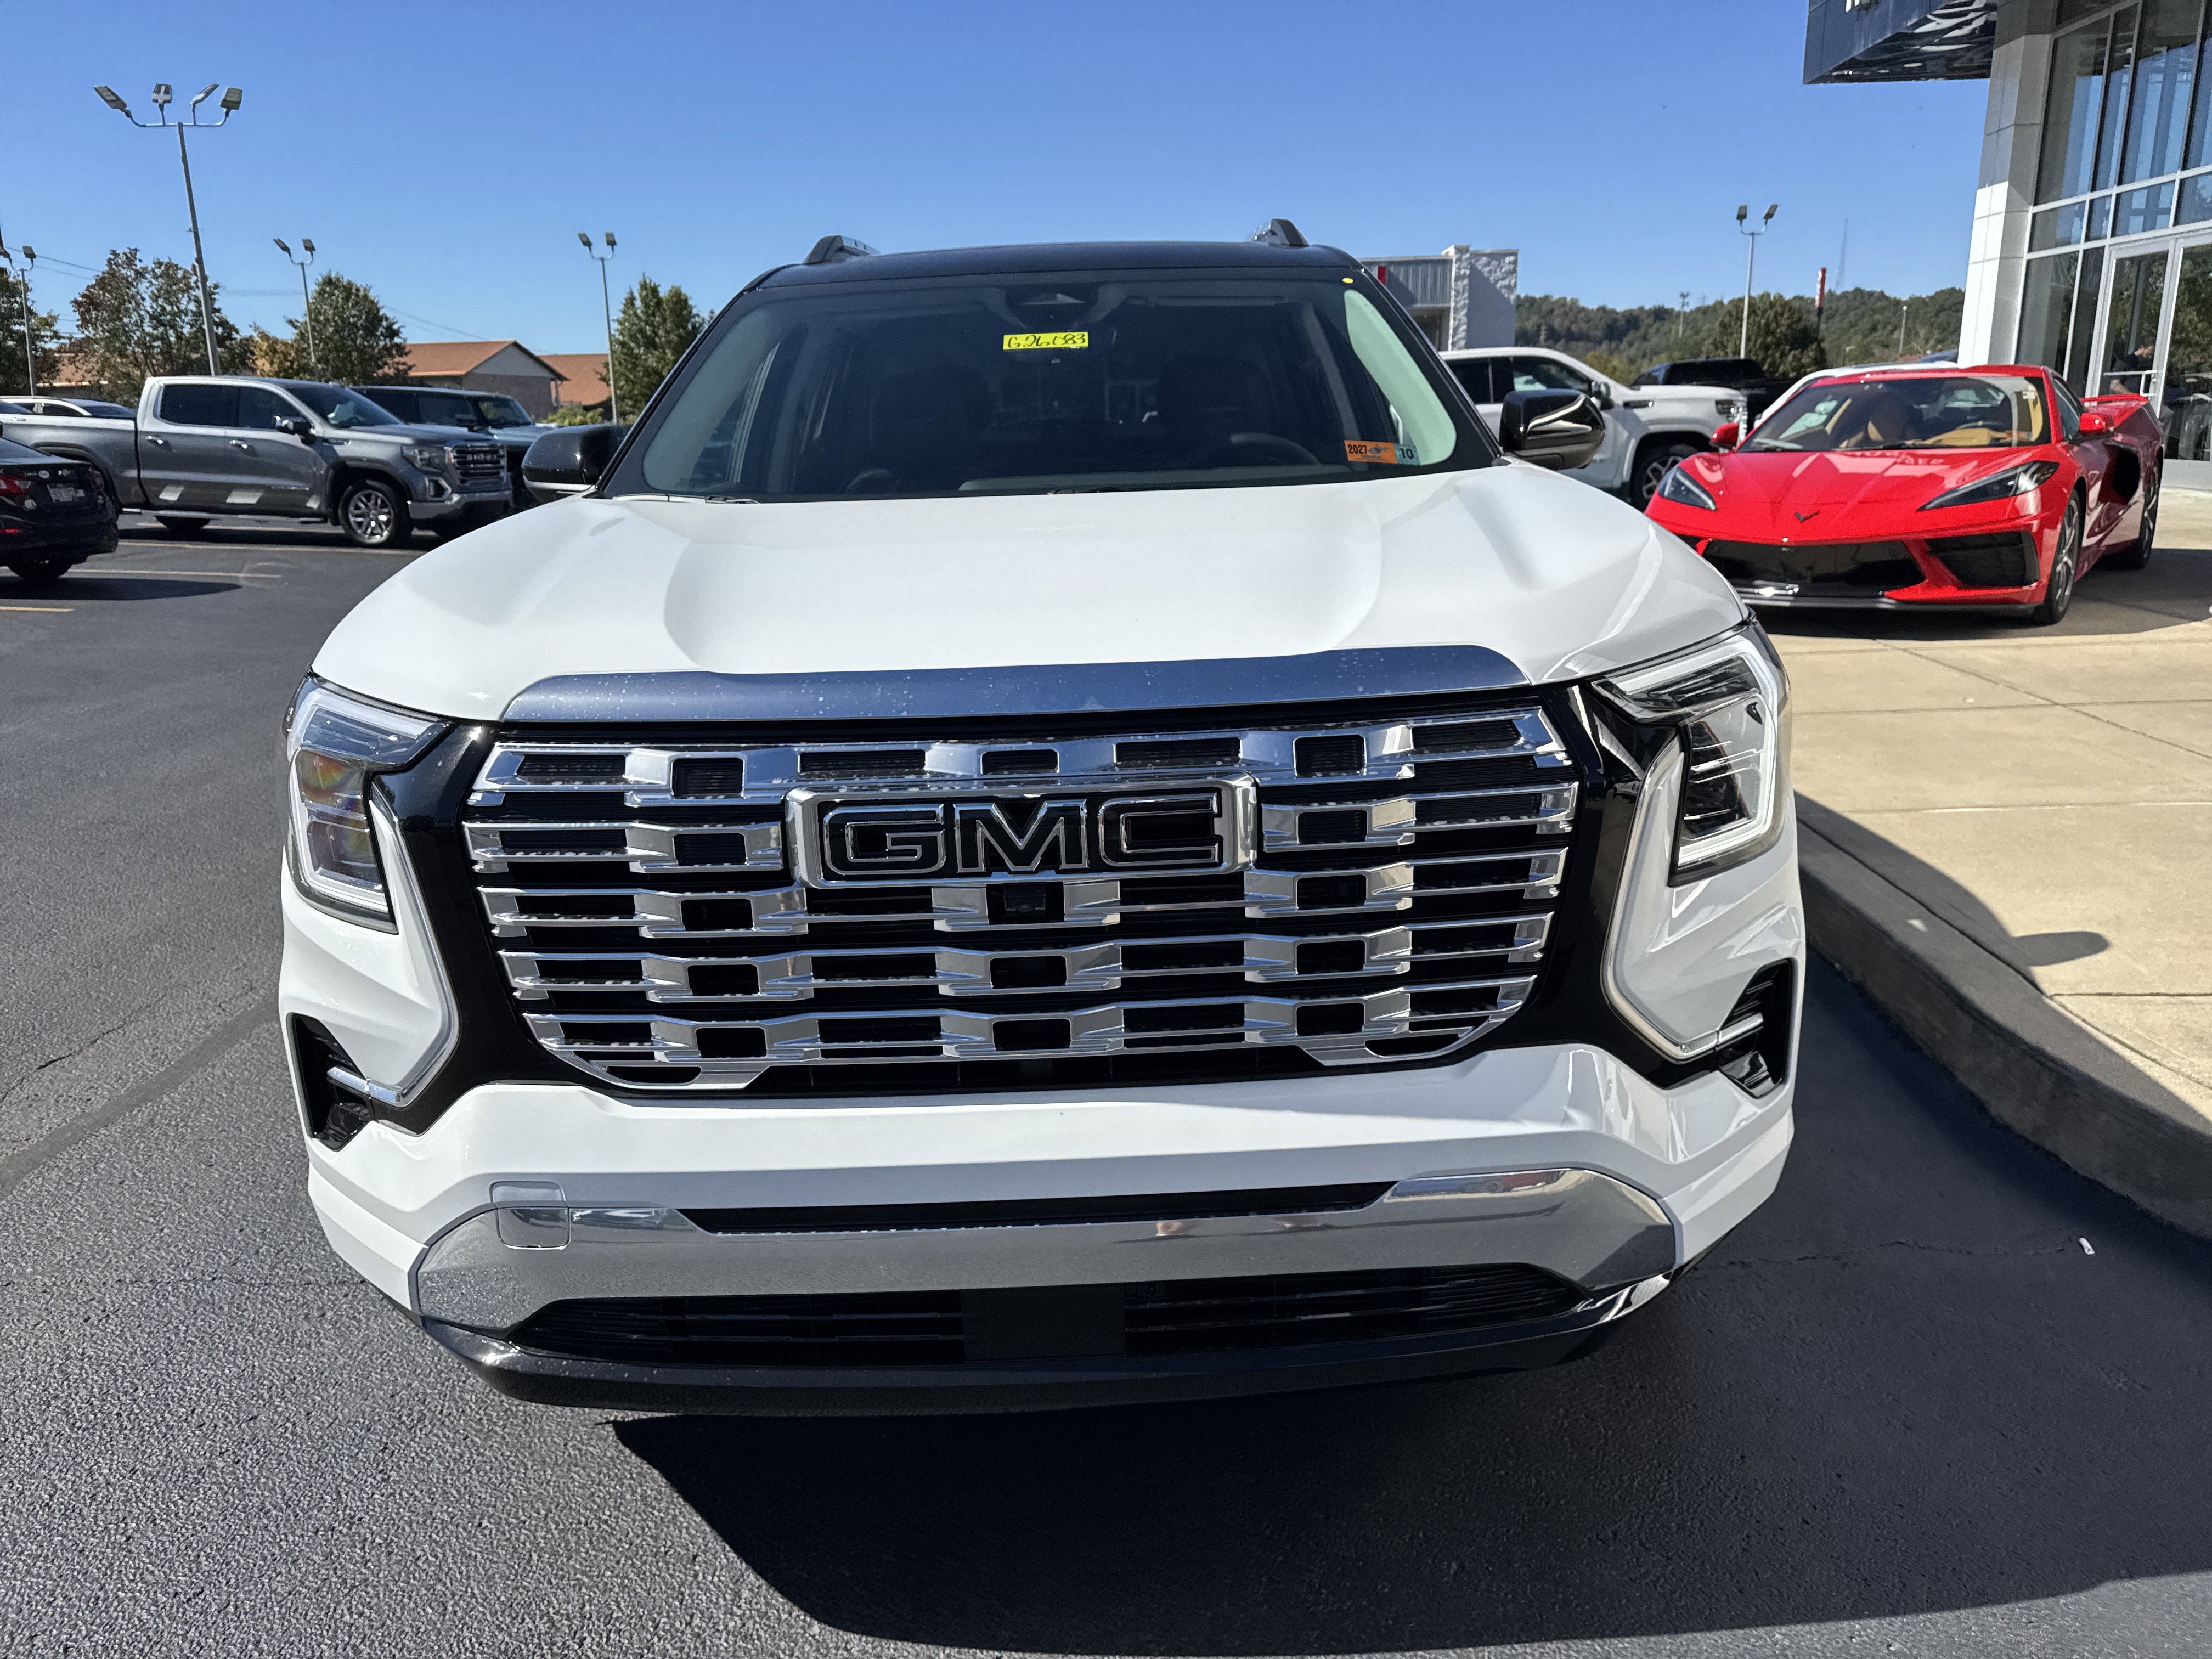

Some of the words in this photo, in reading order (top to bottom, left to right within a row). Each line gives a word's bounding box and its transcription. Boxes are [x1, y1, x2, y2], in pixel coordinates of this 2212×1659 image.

[1348, 444, 1367, 454] 2027
[1400, 448, 1414, 459] 10
[823, 792, 1219, 874] GMC
